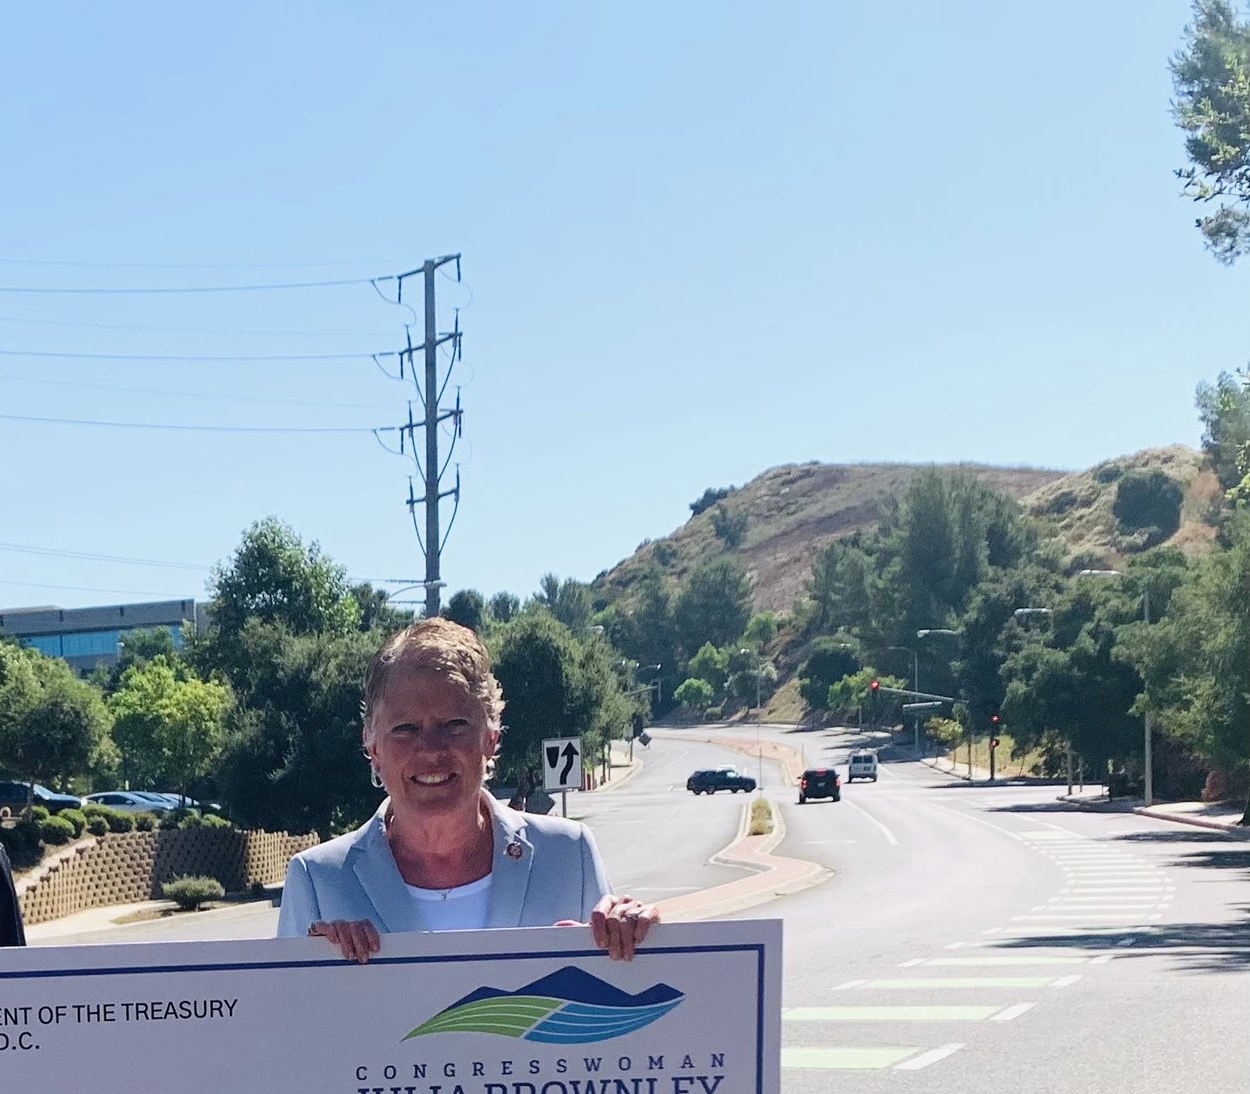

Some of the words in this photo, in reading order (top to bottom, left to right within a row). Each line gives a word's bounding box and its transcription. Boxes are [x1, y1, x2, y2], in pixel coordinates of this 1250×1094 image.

[37, 1005, 68, 1025] OF
[71, 1003, 117, 1024] THE
[120, 998, 239, 1022] TREASURY
[355, 1052, 726, 1081] CONGRESSWOMAN
